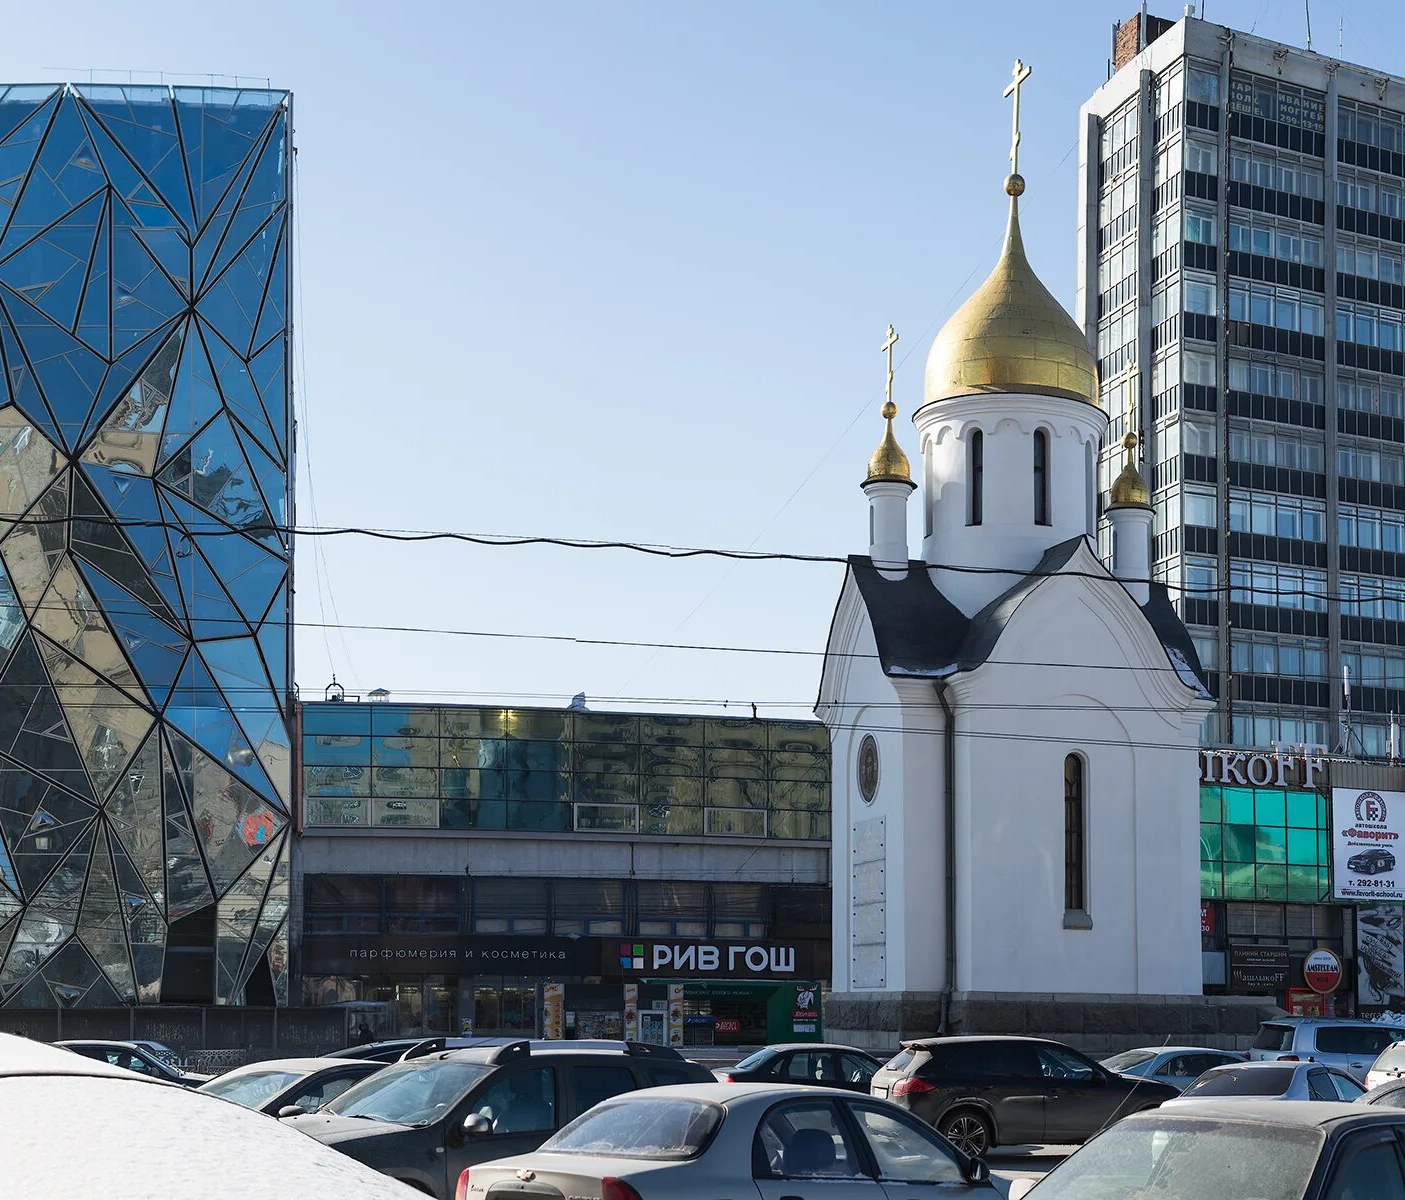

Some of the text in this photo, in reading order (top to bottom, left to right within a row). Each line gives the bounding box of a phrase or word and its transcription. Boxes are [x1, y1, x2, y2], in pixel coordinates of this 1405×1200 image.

[1357, 879, 1395, 888] 292-81-31
[1341, 889, 1402, 898] www.favorit-school.ru
[349, 948, 566, 960] парфюмерия и косметика
[653, 945, 795, 972] РИВ ГОШ
